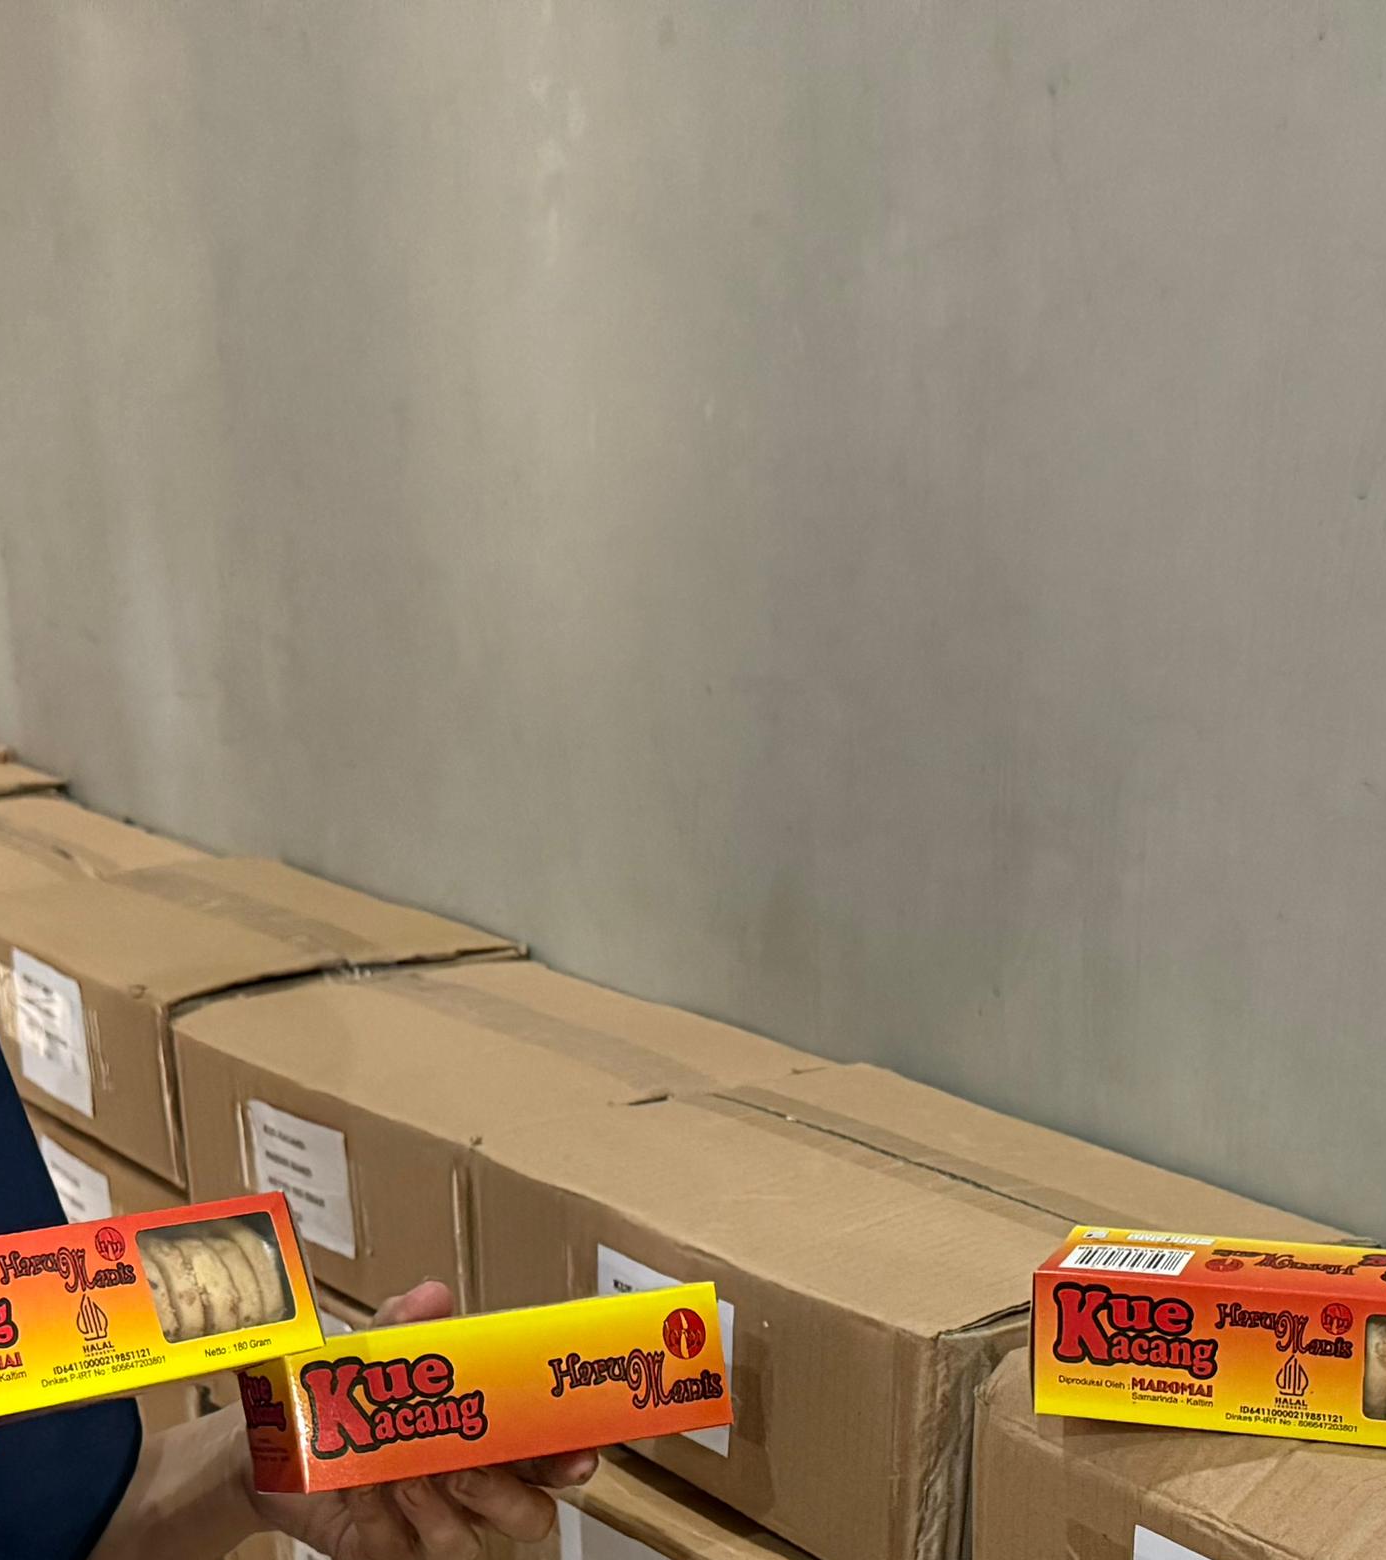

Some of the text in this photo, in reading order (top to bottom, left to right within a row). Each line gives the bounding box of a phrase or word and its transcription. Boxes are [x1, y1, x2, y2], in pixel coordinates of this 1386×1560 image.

[1053, 1281, 1194, 1366] Kue
[83, 1341, 114, 1353] HALAL
[233, 1341, 248, 1353] 180
[249, 1337, 272, 1348] Gram
[300, 1354, 454, 1460] Kue
[1275, 1397, 1308, 1407] HALAL
